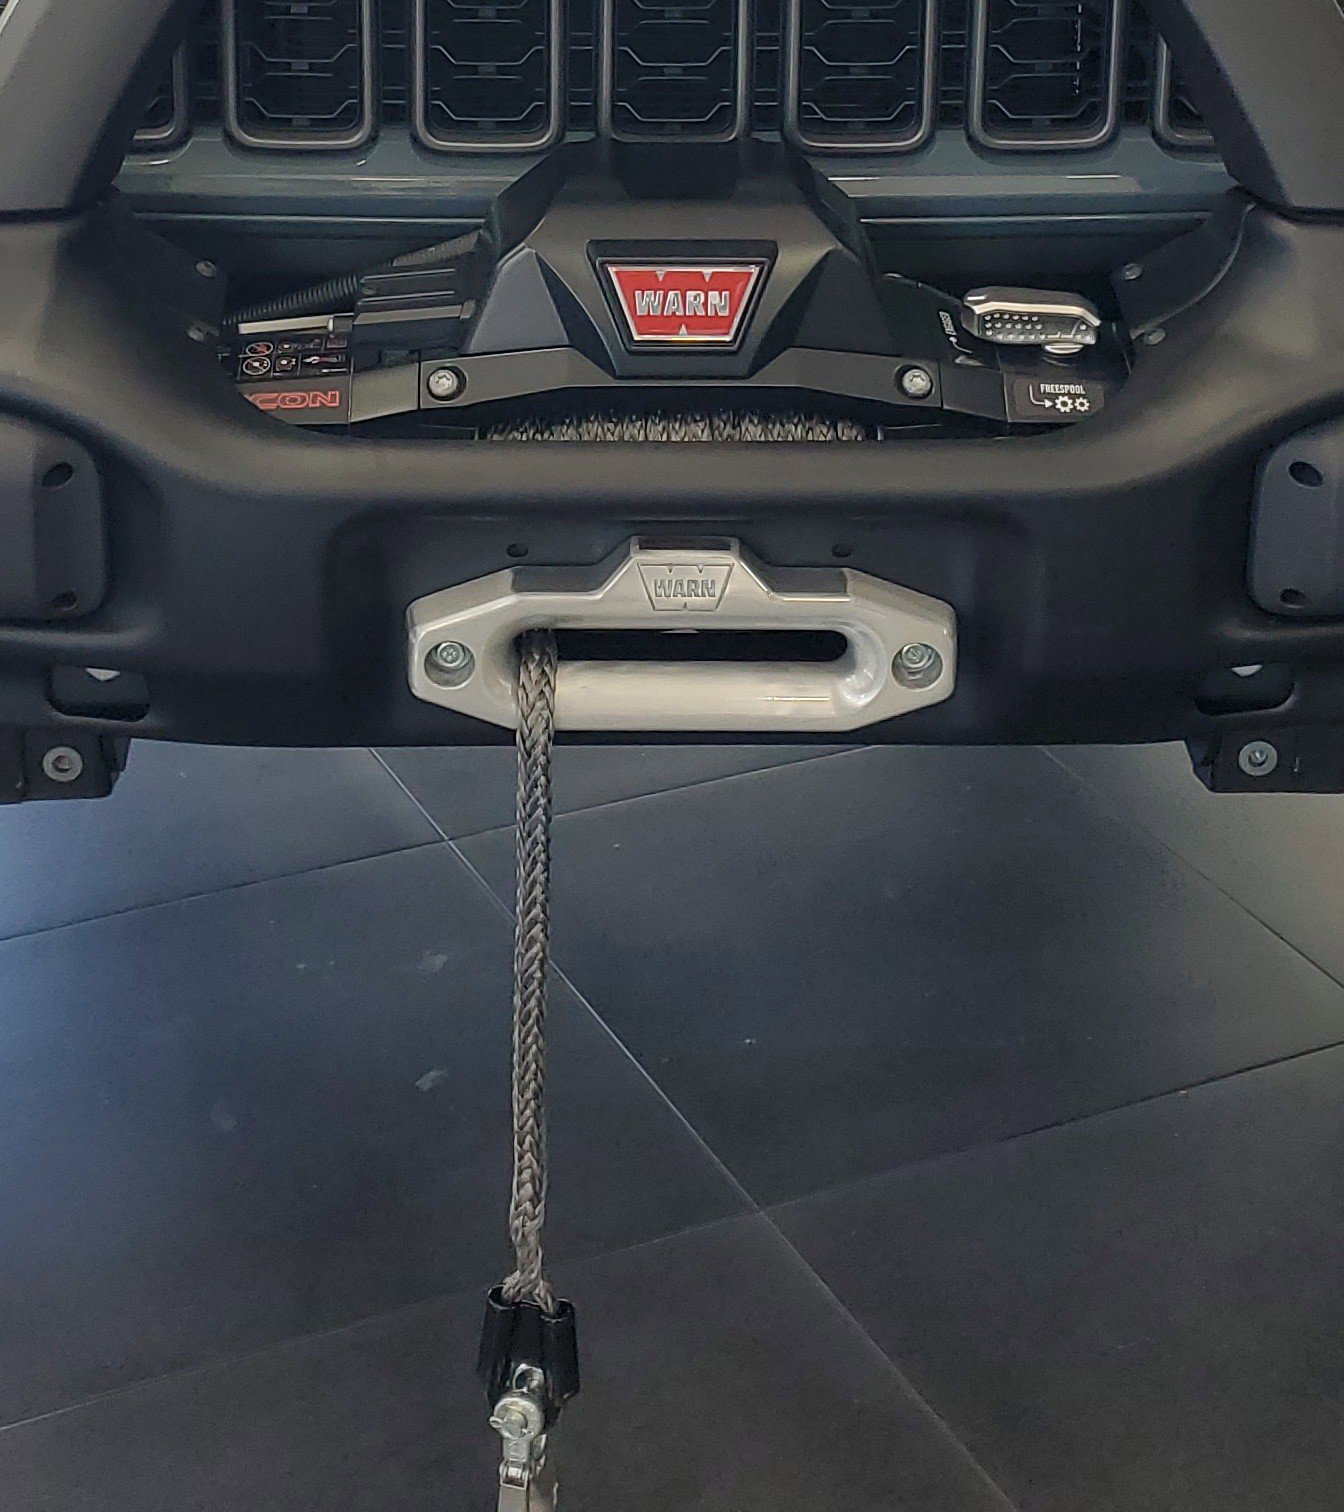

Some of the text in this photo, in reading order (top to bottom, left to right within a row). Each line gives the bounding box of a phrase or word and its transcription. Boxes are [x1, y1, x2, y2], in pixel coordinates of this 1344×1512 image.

[633, 289, 731, 318] WARN
[1040, 383, 1086, 395] FREESPOOL
[654, 577, 717, 599] WARN
